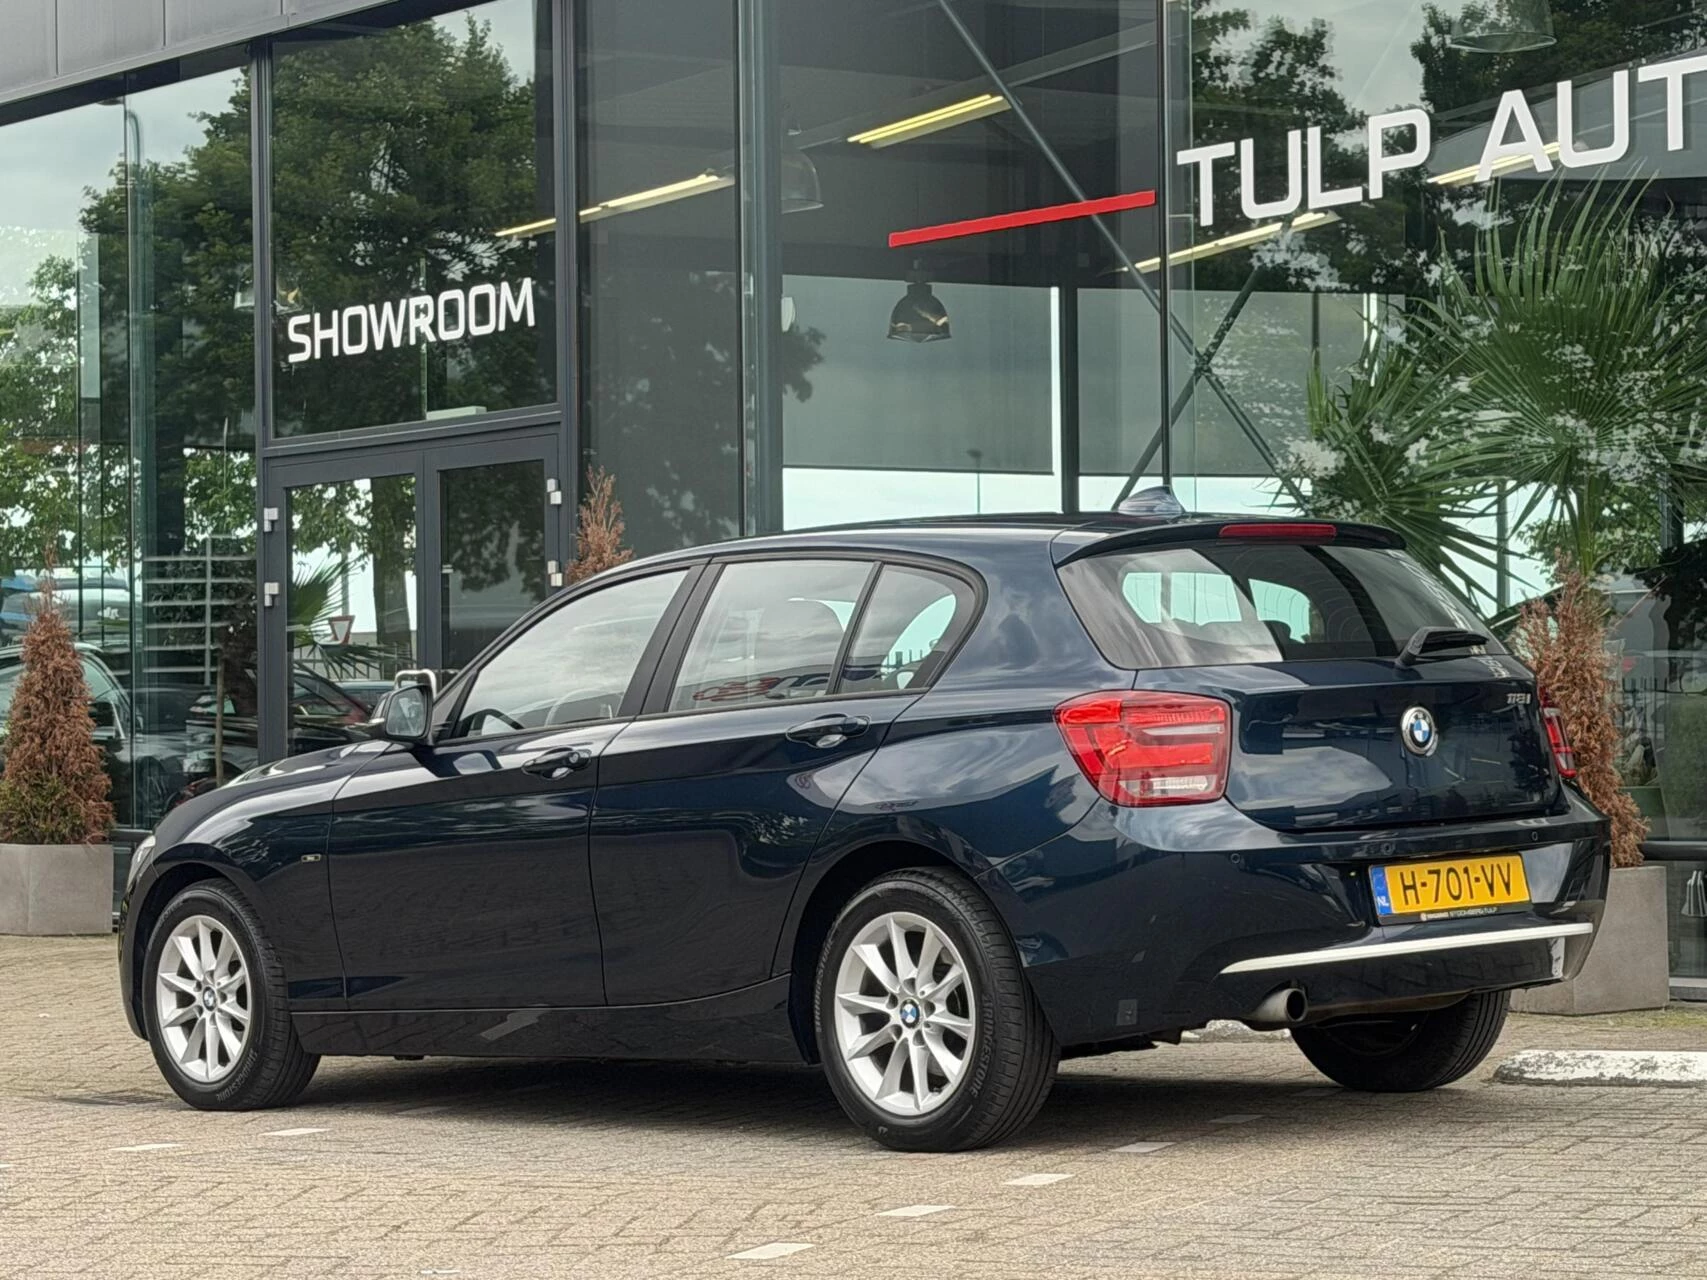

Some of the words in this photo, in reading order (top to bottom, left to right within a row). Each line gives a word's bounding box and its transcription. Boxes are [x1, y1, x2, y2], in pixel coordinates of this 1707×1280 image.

[1176, 108, 1431, 227] TULP
[1475, 56, 1707, 183] AUT
[288, 277, 536, 363] SHOWROOM
[1376, 895, 1390, 907] NL
[1399, 863, 1511, 906] H-701-VV
